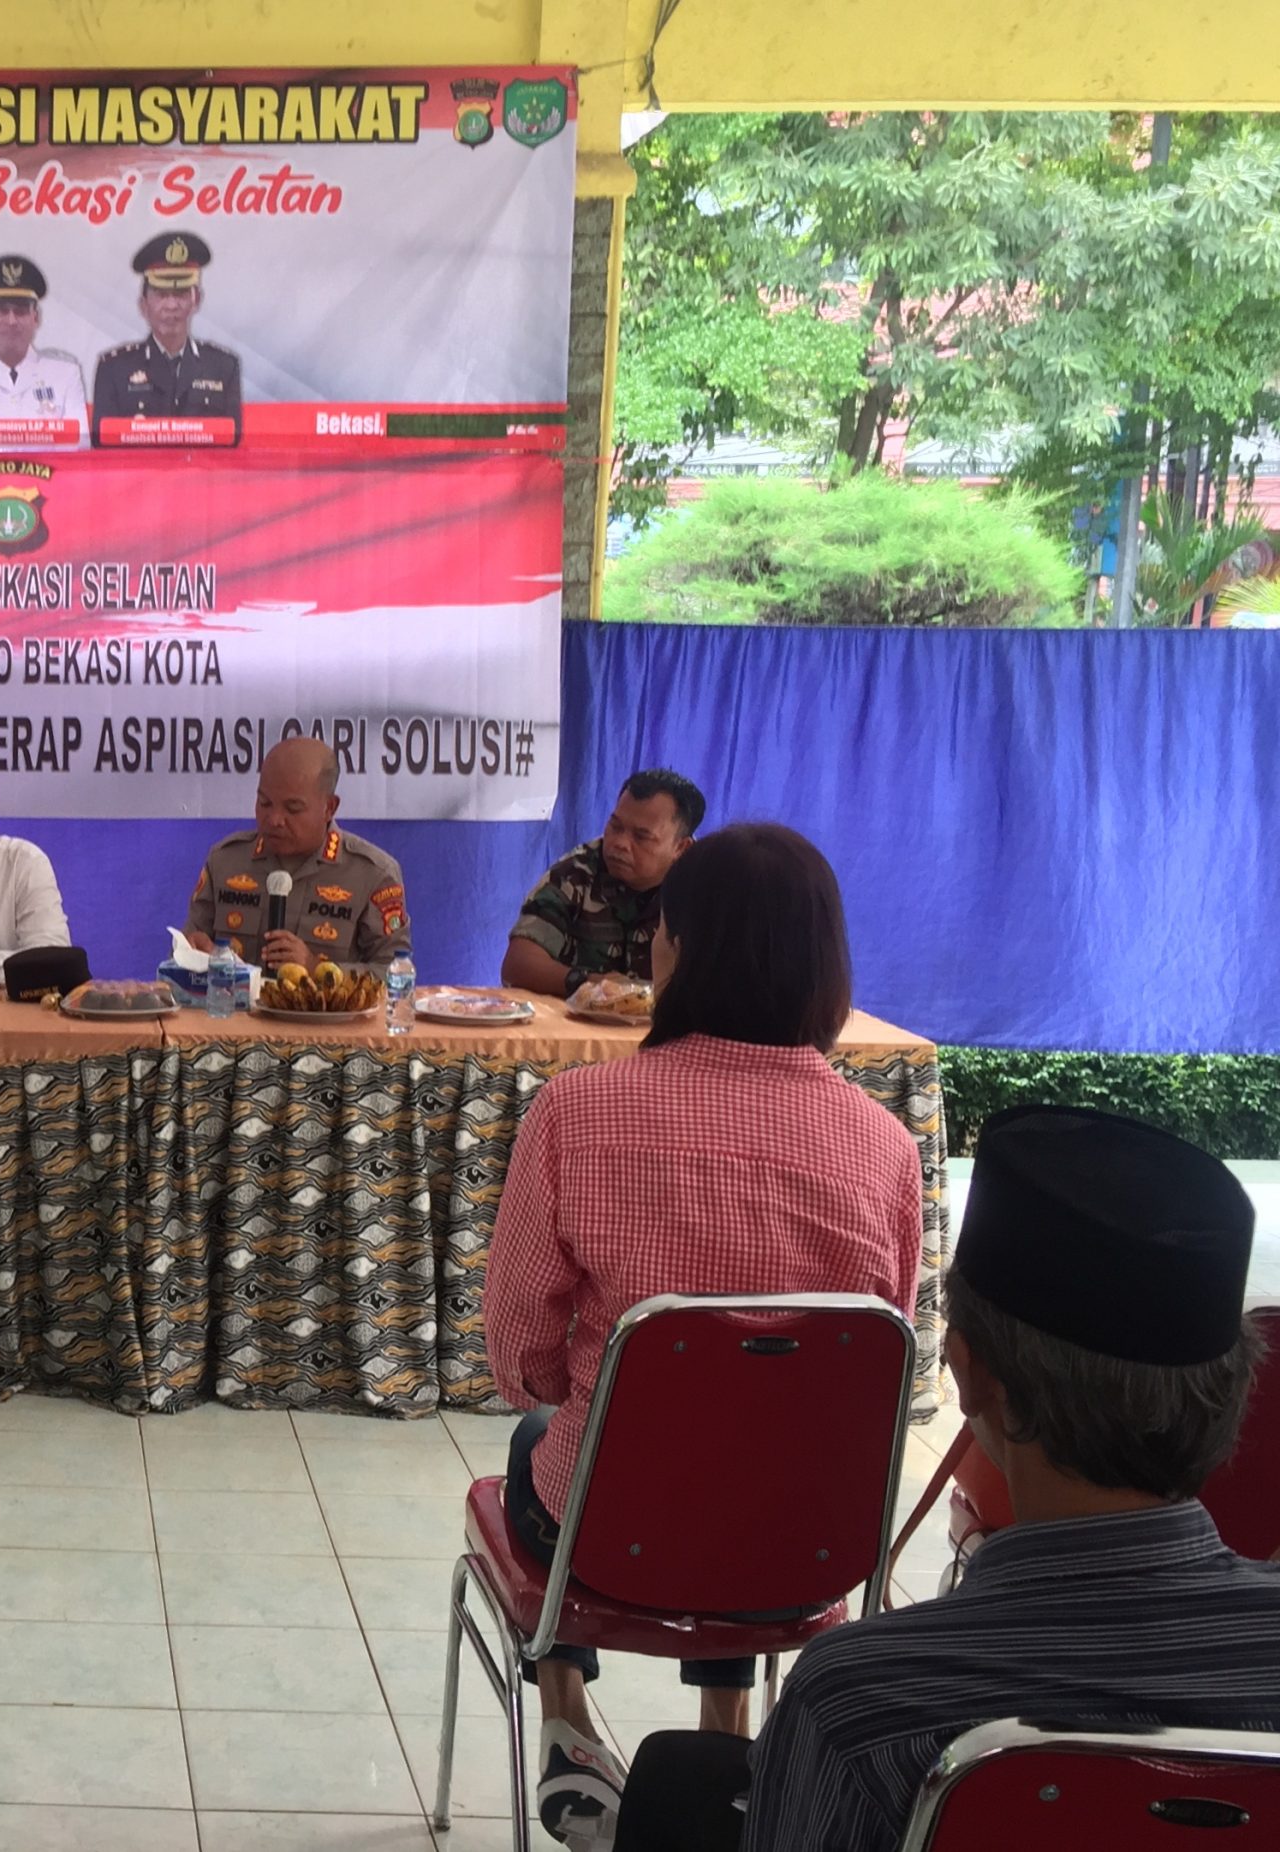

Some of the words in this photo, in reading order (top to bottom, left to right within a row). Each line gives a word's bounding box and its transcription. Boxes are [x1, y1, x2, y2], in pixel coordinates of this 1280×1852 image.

[51, 85, 426, 145] MASYARAKAT
[154, 164, 343, 215] Selatan
[315, 412, 385, 436] Bekasi,
[20, 461, 51, 480] JAYA
[82, 564, 217, 610] SELATAN
[24, 640, 131, 686] BEKASI
[144, 640, 222, 686] KOTA
[95, 717, 265, 775] ASPIRASI
[381, 718, 535, 777] SOLUSI#
[218, 890, 261, 908] HENGKI
[308, 902, 352, 920] POLRI
